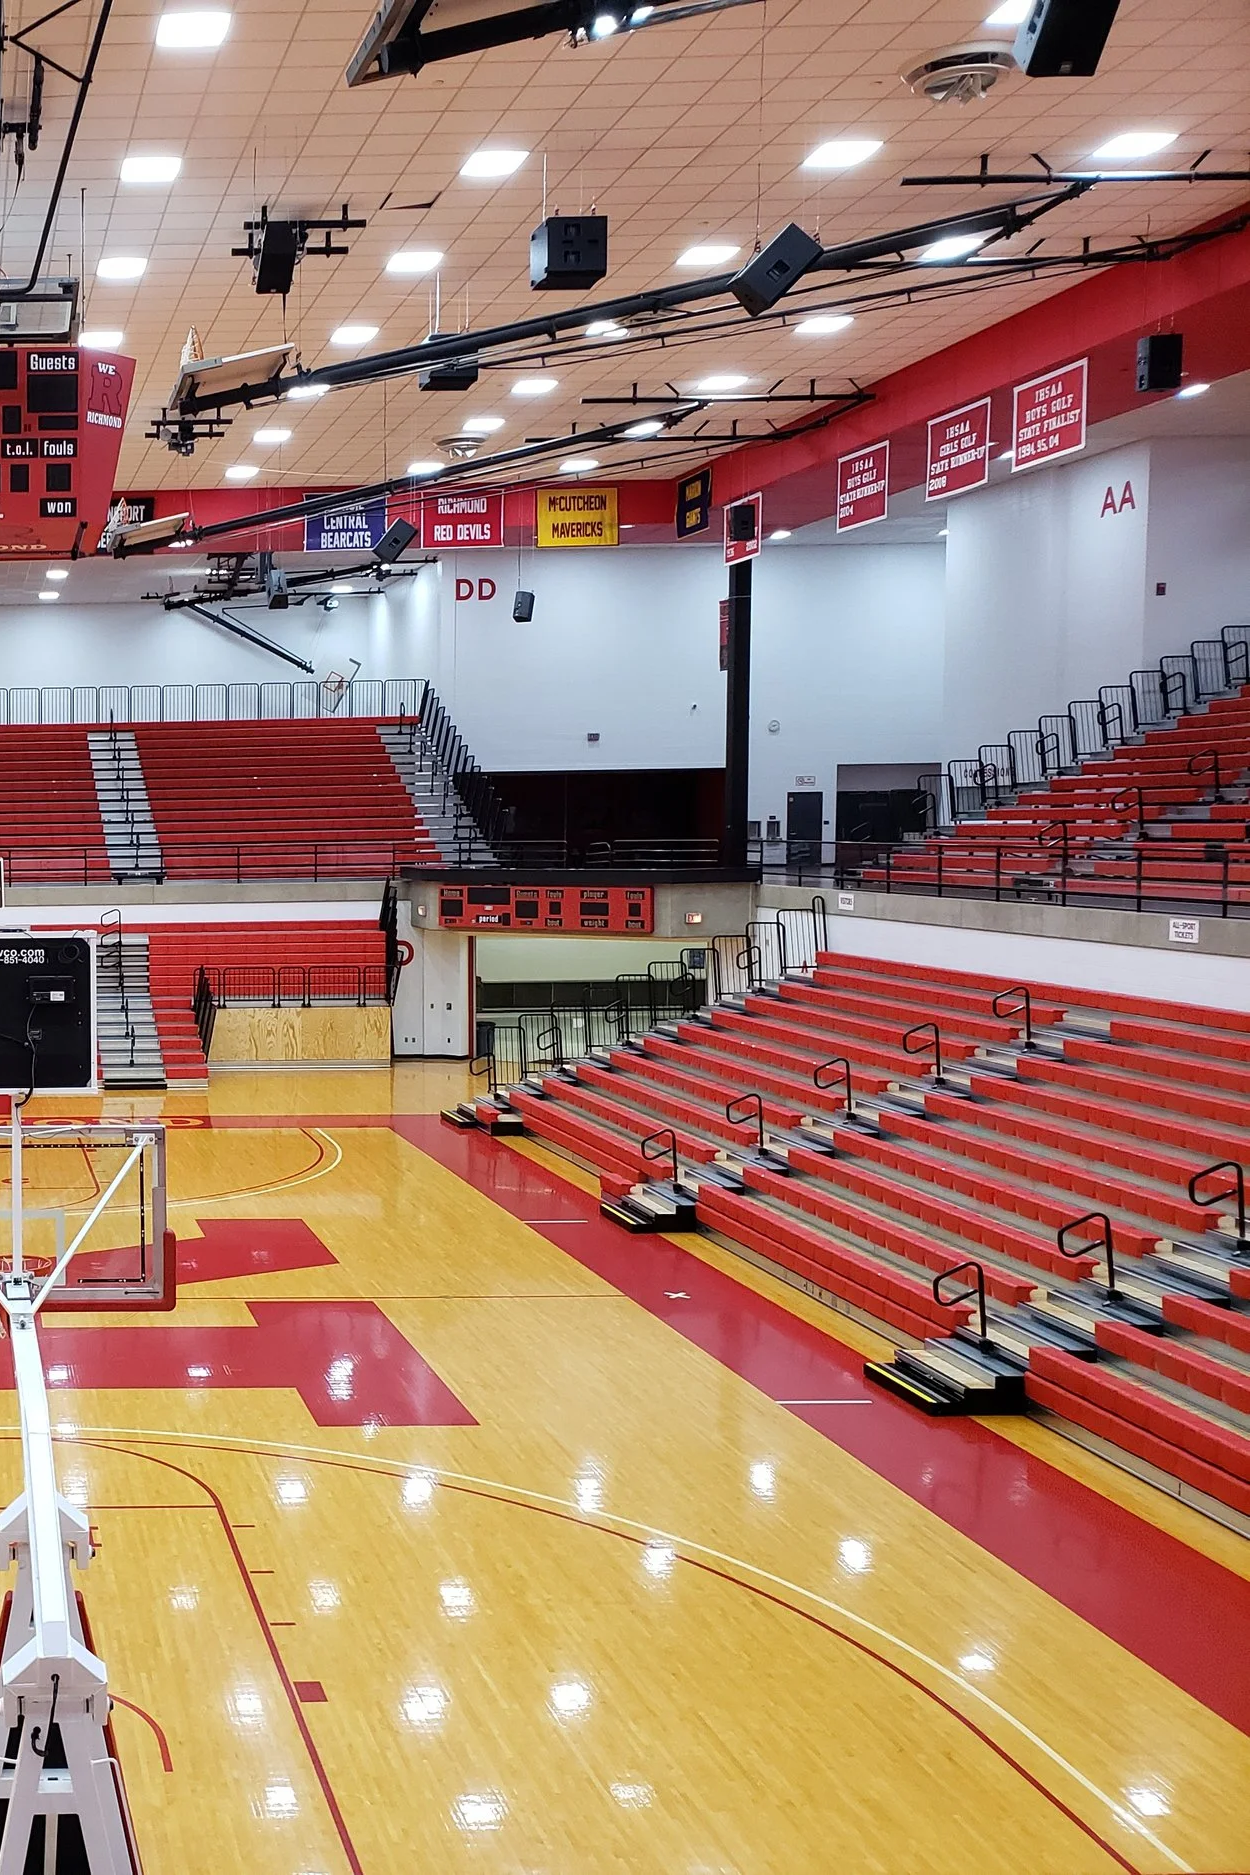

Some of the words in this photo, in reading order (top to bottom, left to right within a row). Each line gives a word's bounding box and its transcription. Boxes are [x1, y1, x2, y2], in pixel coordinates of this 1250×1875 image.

[30, 354, 75, 371] Guests
[97, 362, 116, 376] WE
[1025, 403, 1048, 424] BOYS
[1051, 393, 1074, 414] GOLF
[86, 411, 122, 429] RICHMOND
[1018, 422, 1042, 443] STATE
[1043, 408, 1081, 433] FINALIST
[6, 441, 33, 456] t.o.l.
[44, 440, 74, 456] fouls
[47, 501, 73, 514] won
[437, 497, 487, 515] RICHMOND
[1100, 480, 1136, 518] AA
[323, 513, 369, 530] CENTRAL
[552, 521, 603, 539] MAVERICKS
[320, 531, 372, 549] BEARCATS
[433, 524, 453, 542] RED
[456, 523, 491, 541] DEVILS
[455, 578, 497, 601] DD
[478, 915, 499, 923] period
